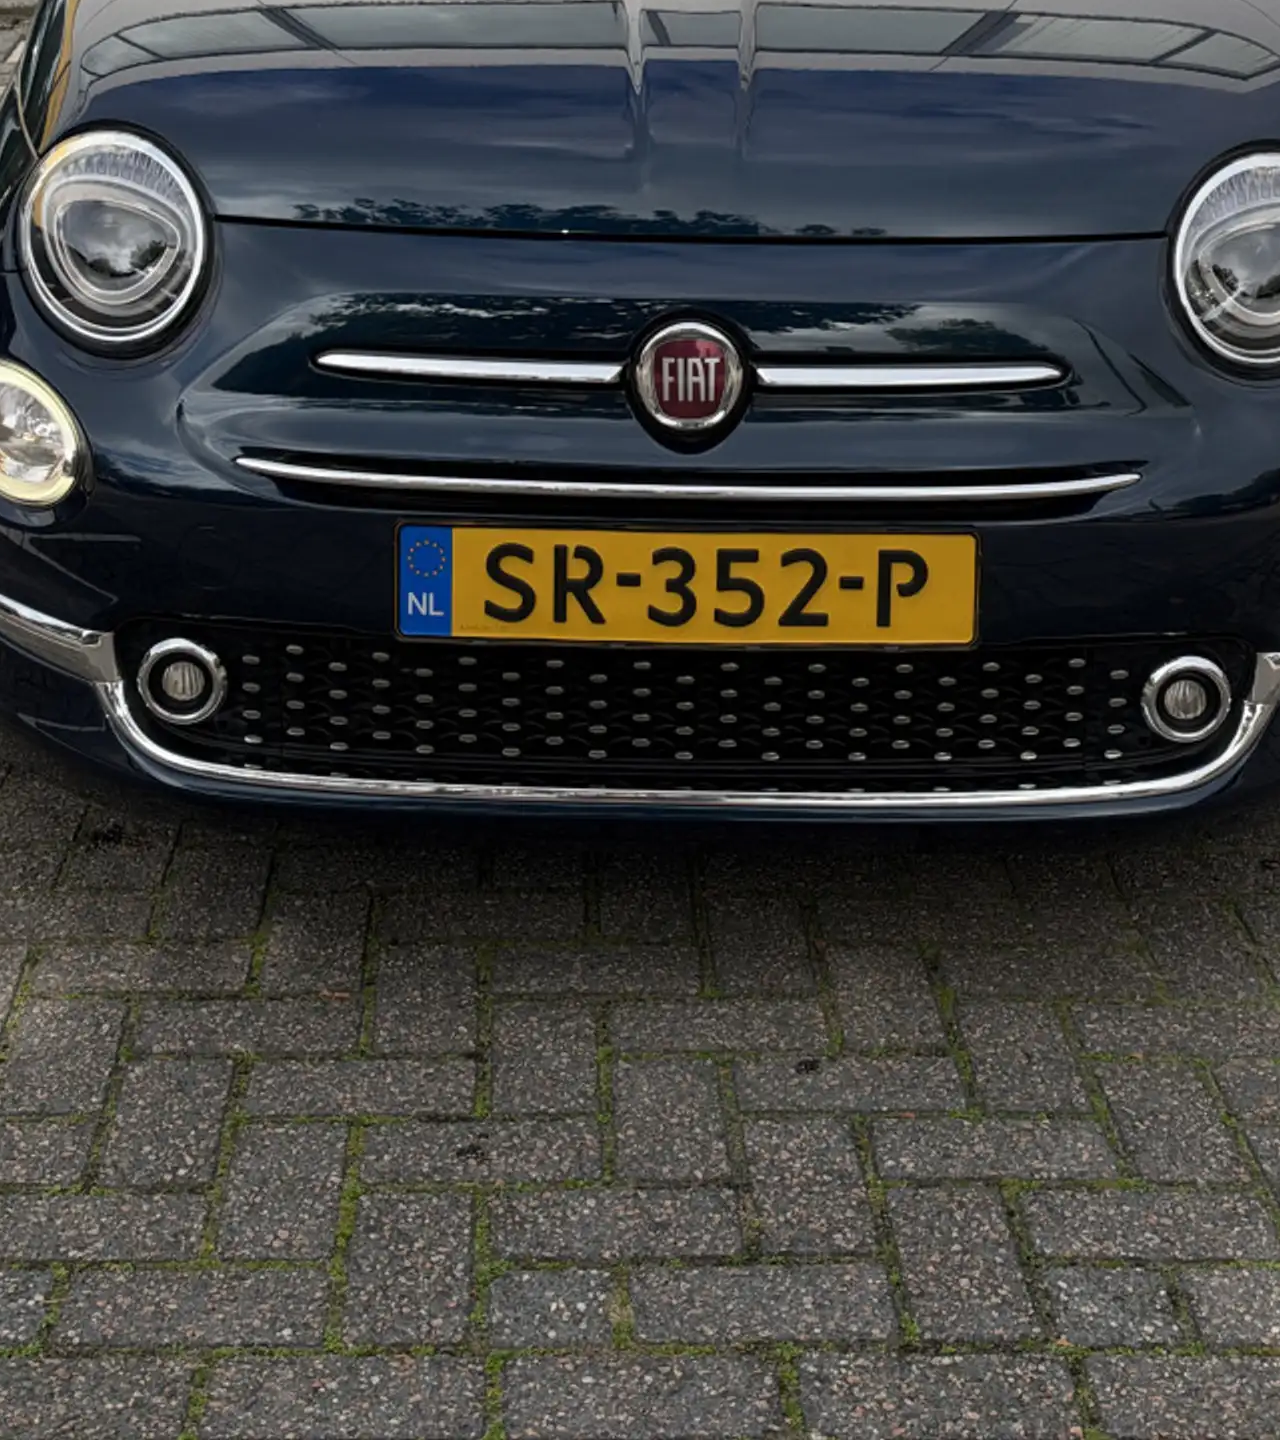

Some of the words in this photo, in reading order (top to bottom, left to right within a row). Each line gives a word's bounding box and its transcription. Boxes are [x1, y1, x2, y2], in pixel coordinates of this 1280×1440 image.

[661, 356, 721, 402] FIAT
[407, 591, 445, 616] NL
[483, 541, 930, 629] SR-352-P
